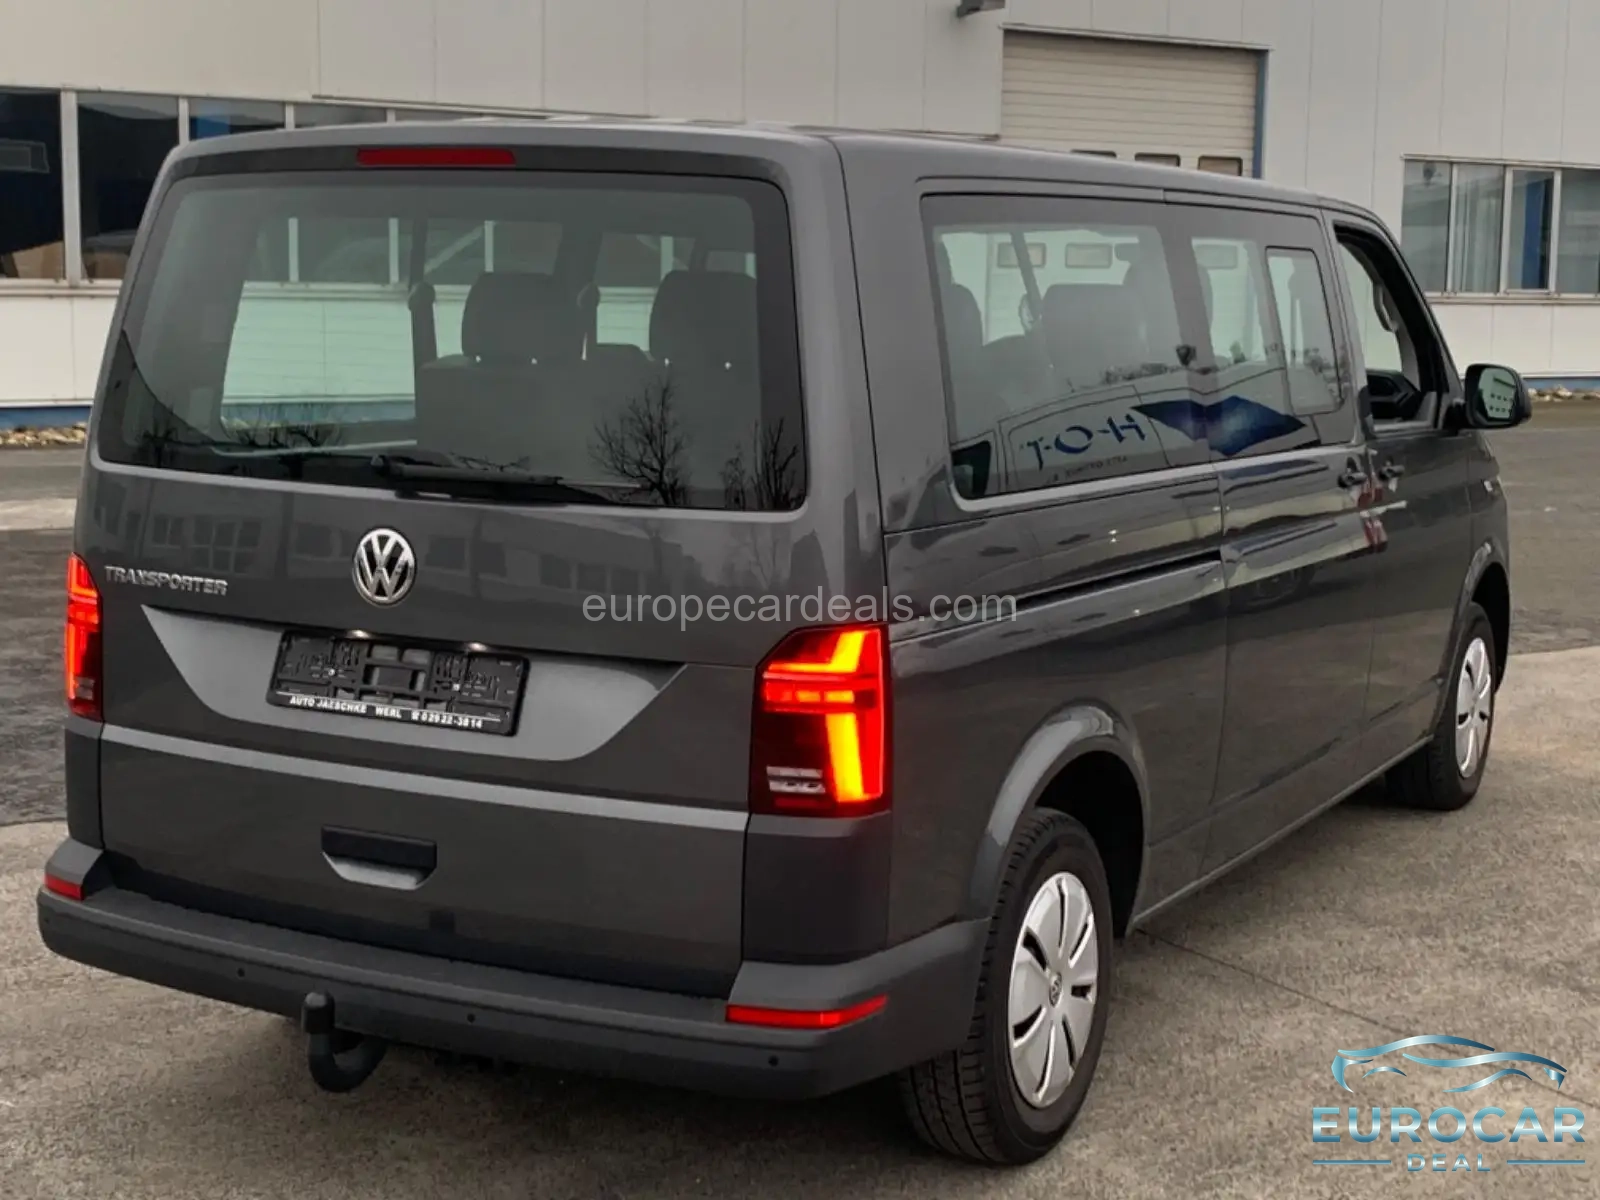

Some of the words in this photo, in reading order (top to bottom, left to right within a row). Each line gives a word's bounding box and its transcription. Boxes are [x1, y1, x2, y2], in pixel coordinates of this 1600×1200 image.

[105, 565, 228, 595] TRANSPORTER
[290, 696, 315, 707] AUTO
[316, 697, 367, 714] JAESCHKE
[375, 706, 402, 718] WERL
